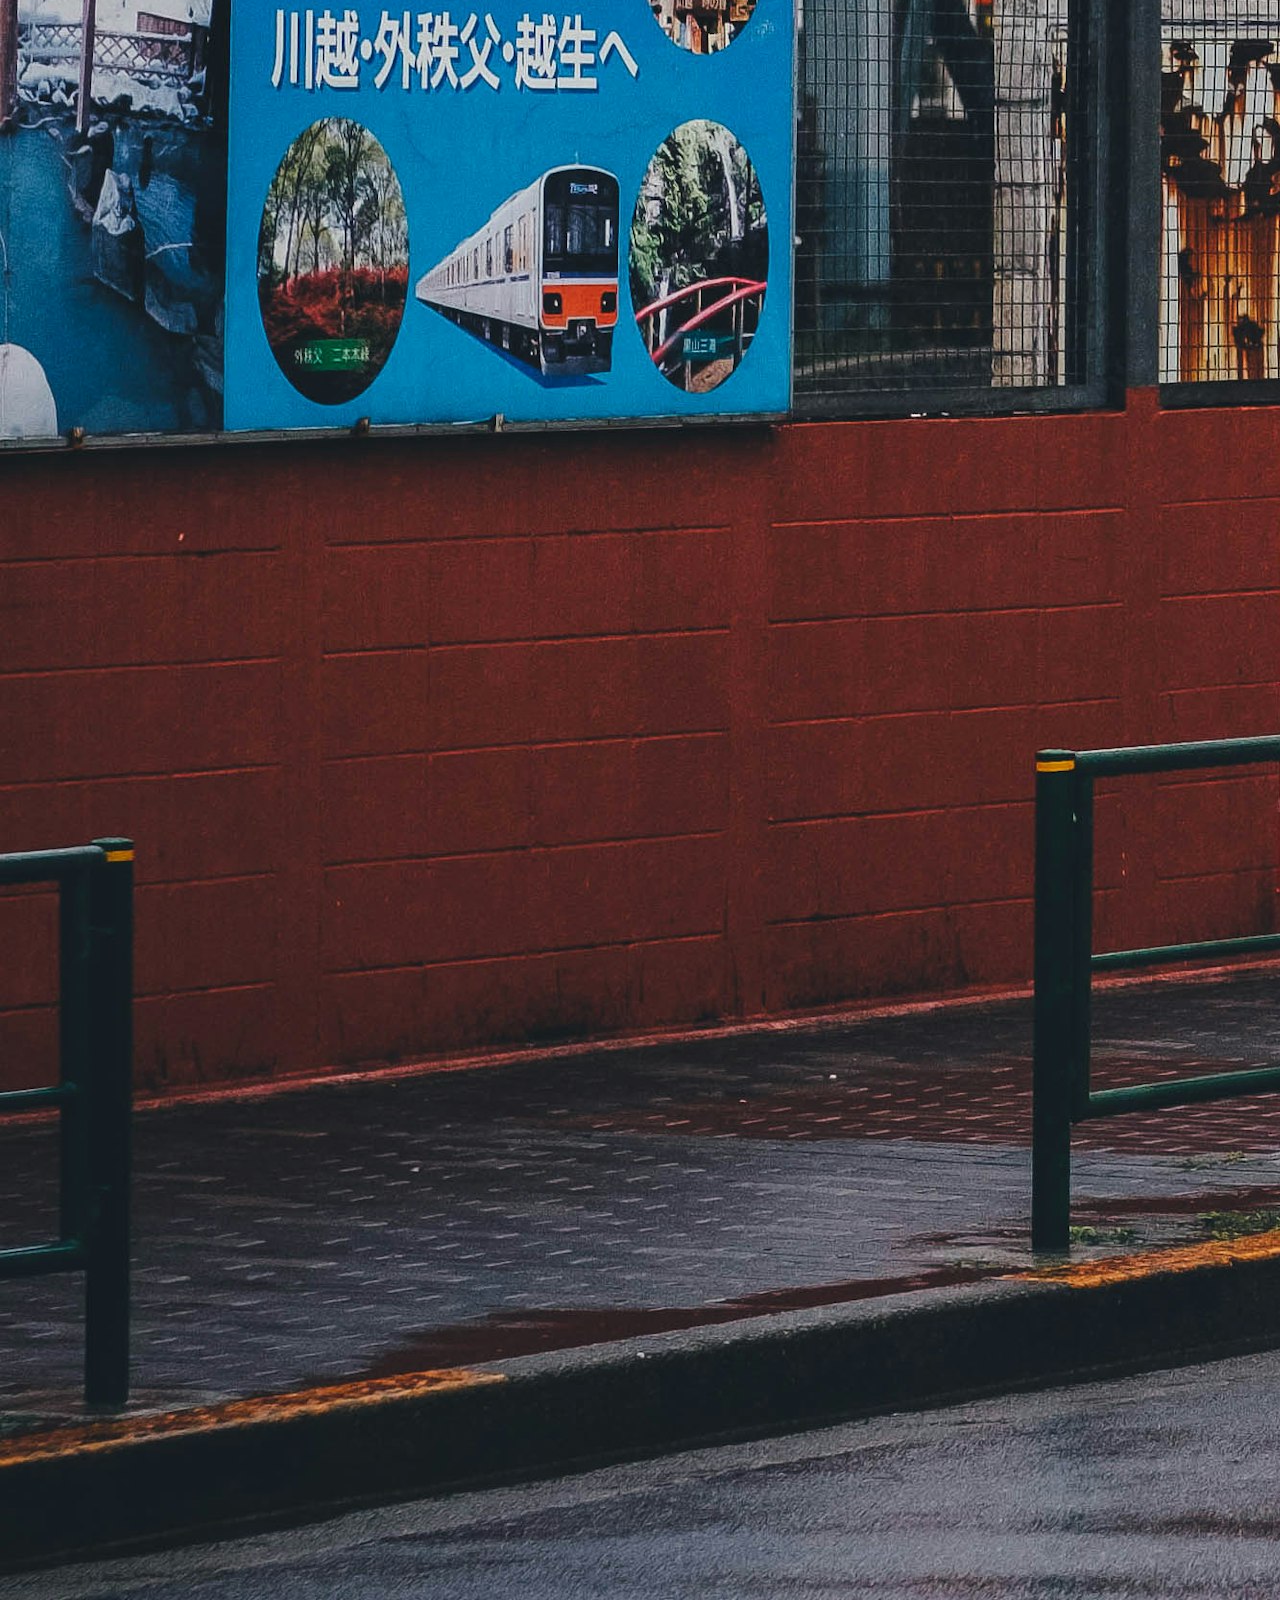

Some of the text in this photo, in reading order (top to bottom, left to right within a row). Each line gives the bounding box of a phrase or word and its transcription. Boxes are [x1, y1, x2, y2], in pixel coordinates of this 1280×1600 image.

[271, 8, 640, 90] 川越・外秩父・越生へ
